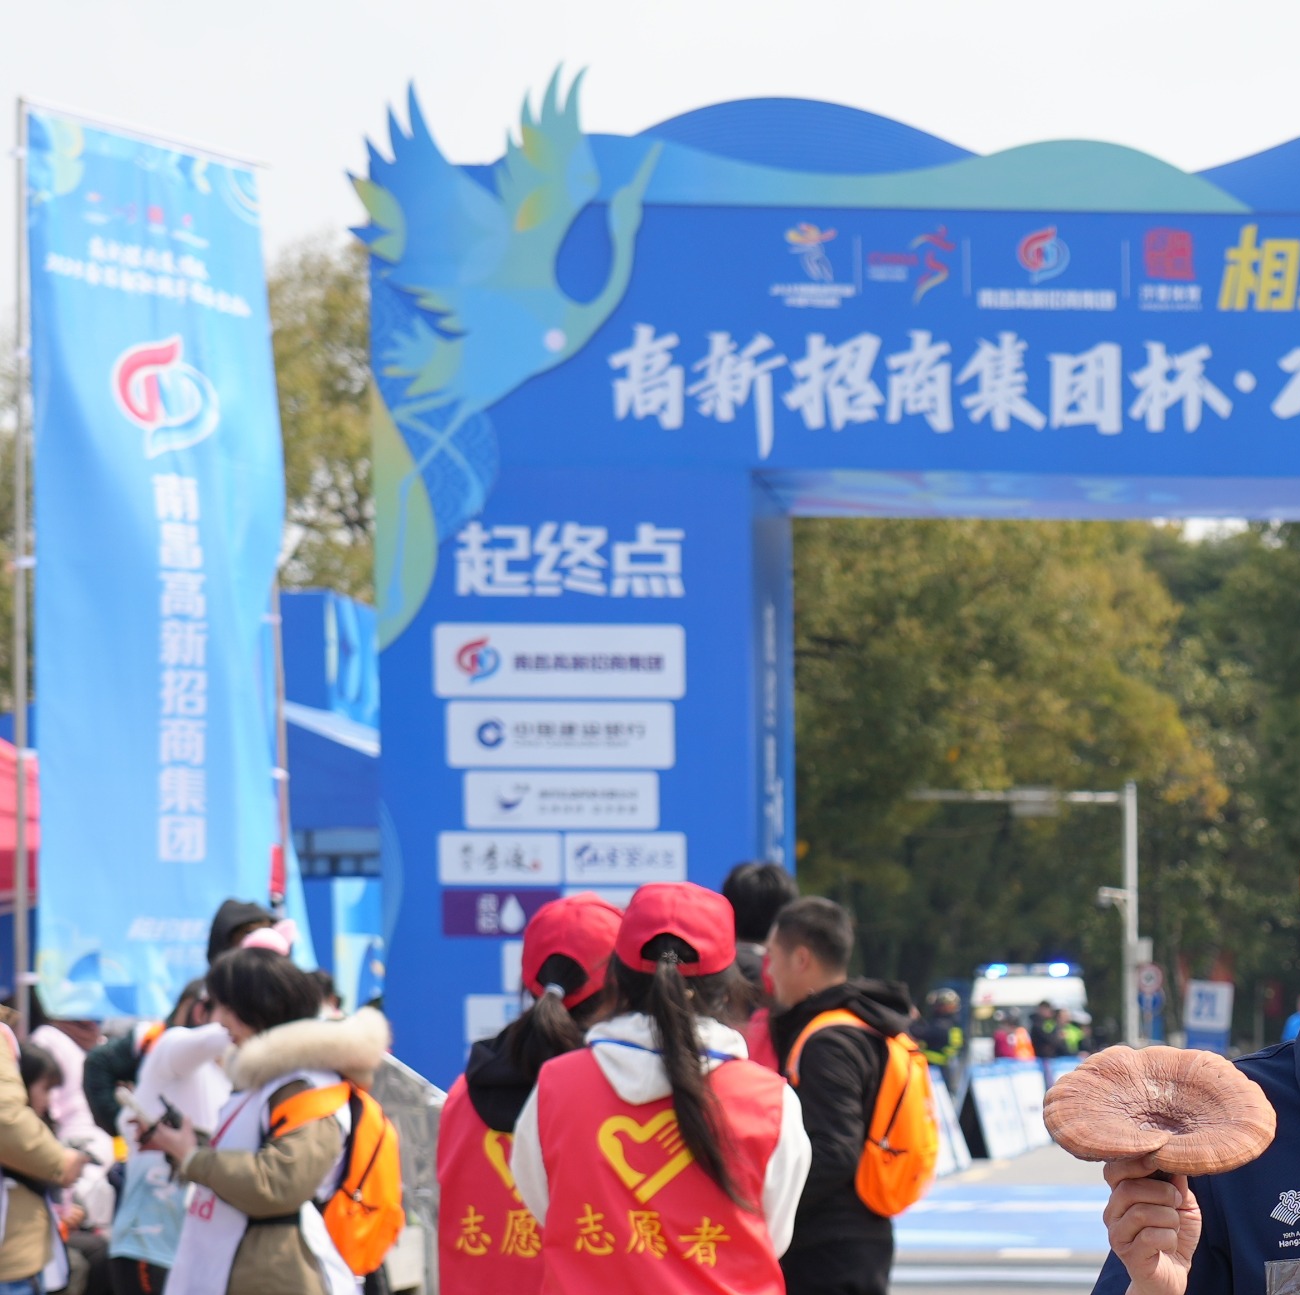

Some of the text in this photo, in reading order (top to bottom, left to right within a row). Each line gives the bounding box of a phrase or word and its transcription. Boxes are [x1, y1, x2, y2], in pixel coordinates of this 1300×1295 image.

[454, 522, 686, 598] 起终点
[153, 473, 208, 862] 南昌高新招商集团
[574, 1202, 731, 1268] 志愿者
